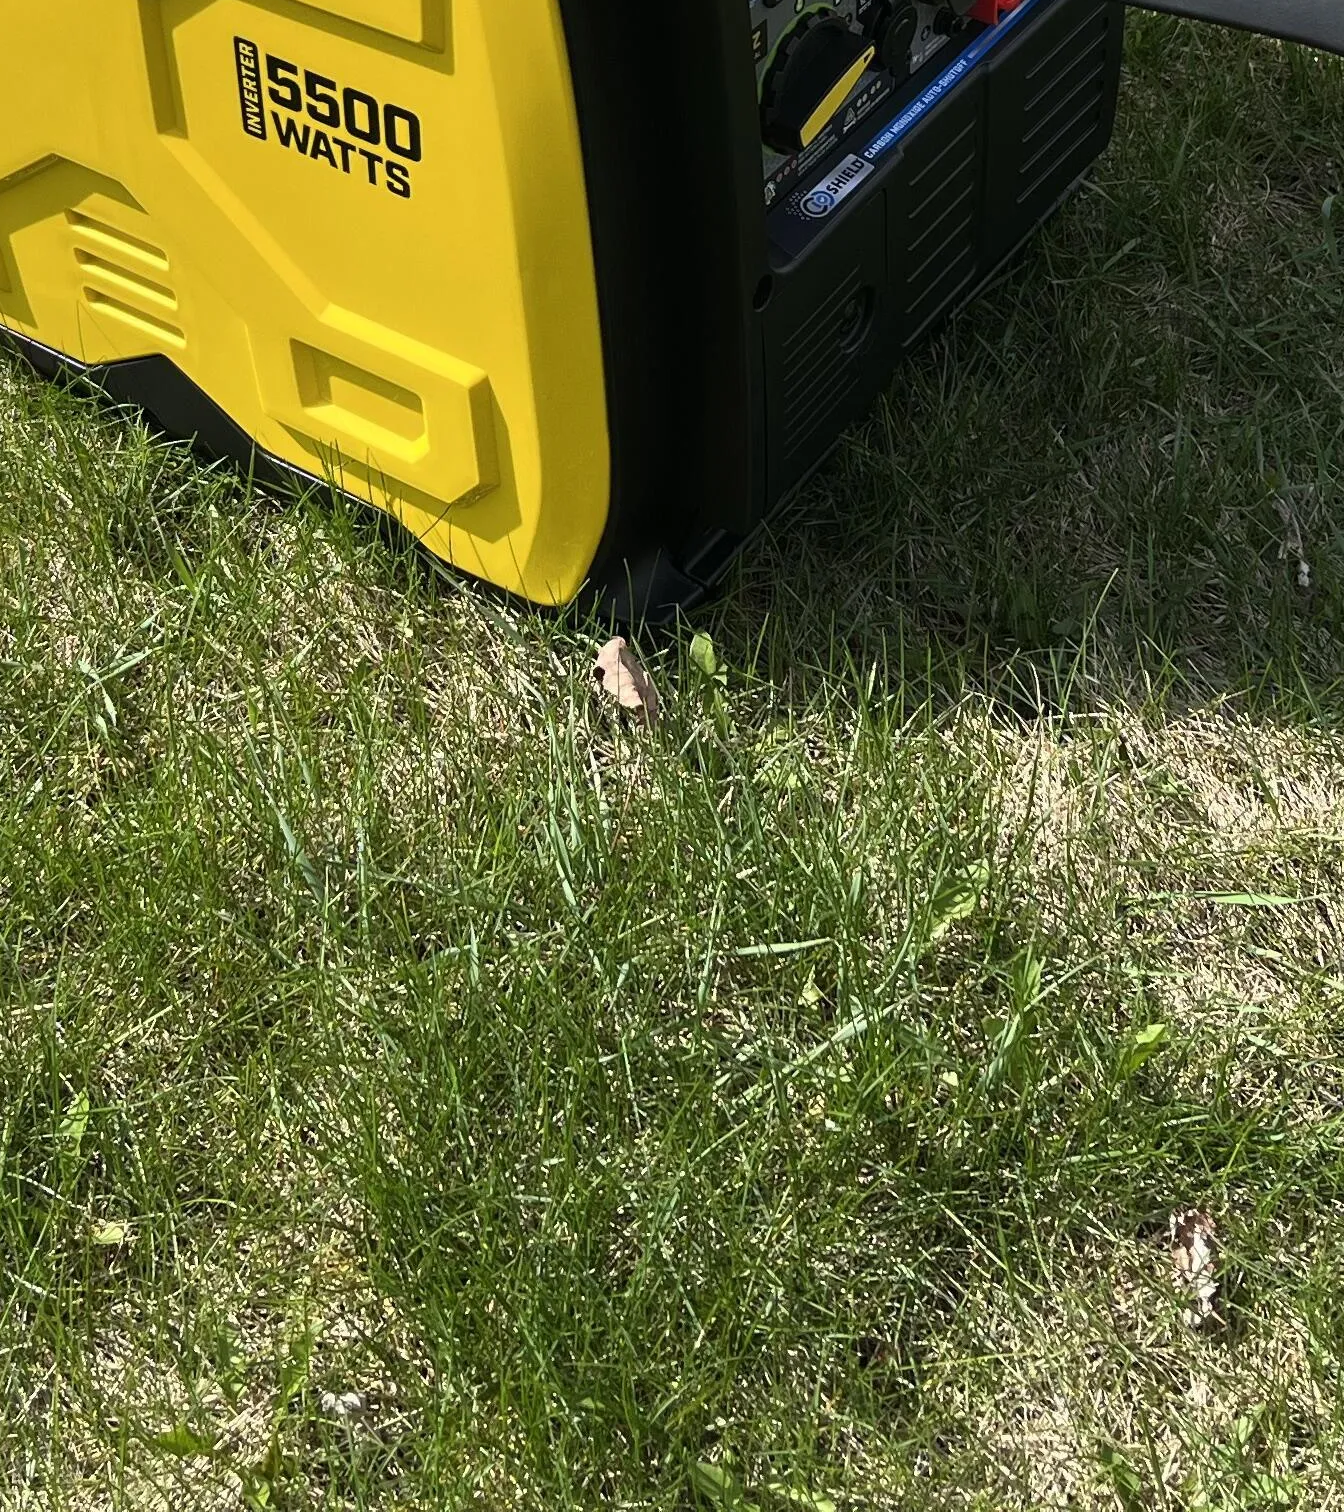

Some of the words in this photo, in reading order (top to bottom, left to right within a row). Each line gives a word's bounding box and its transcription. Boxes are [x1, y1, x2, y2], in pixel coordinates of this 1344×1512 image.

[238, 41, 263, 135] INVERTER
[265, 52, 422, 163] 5500
[864, 131, 895, 159] CARBON
[890, 101, 926, 134] MONOXIDE
[922, 58, 968, 104] AUTO-SHUTOFF
[270, 109, 411, 199] WATTS
[825, 160, 865, 195] SHIELD
